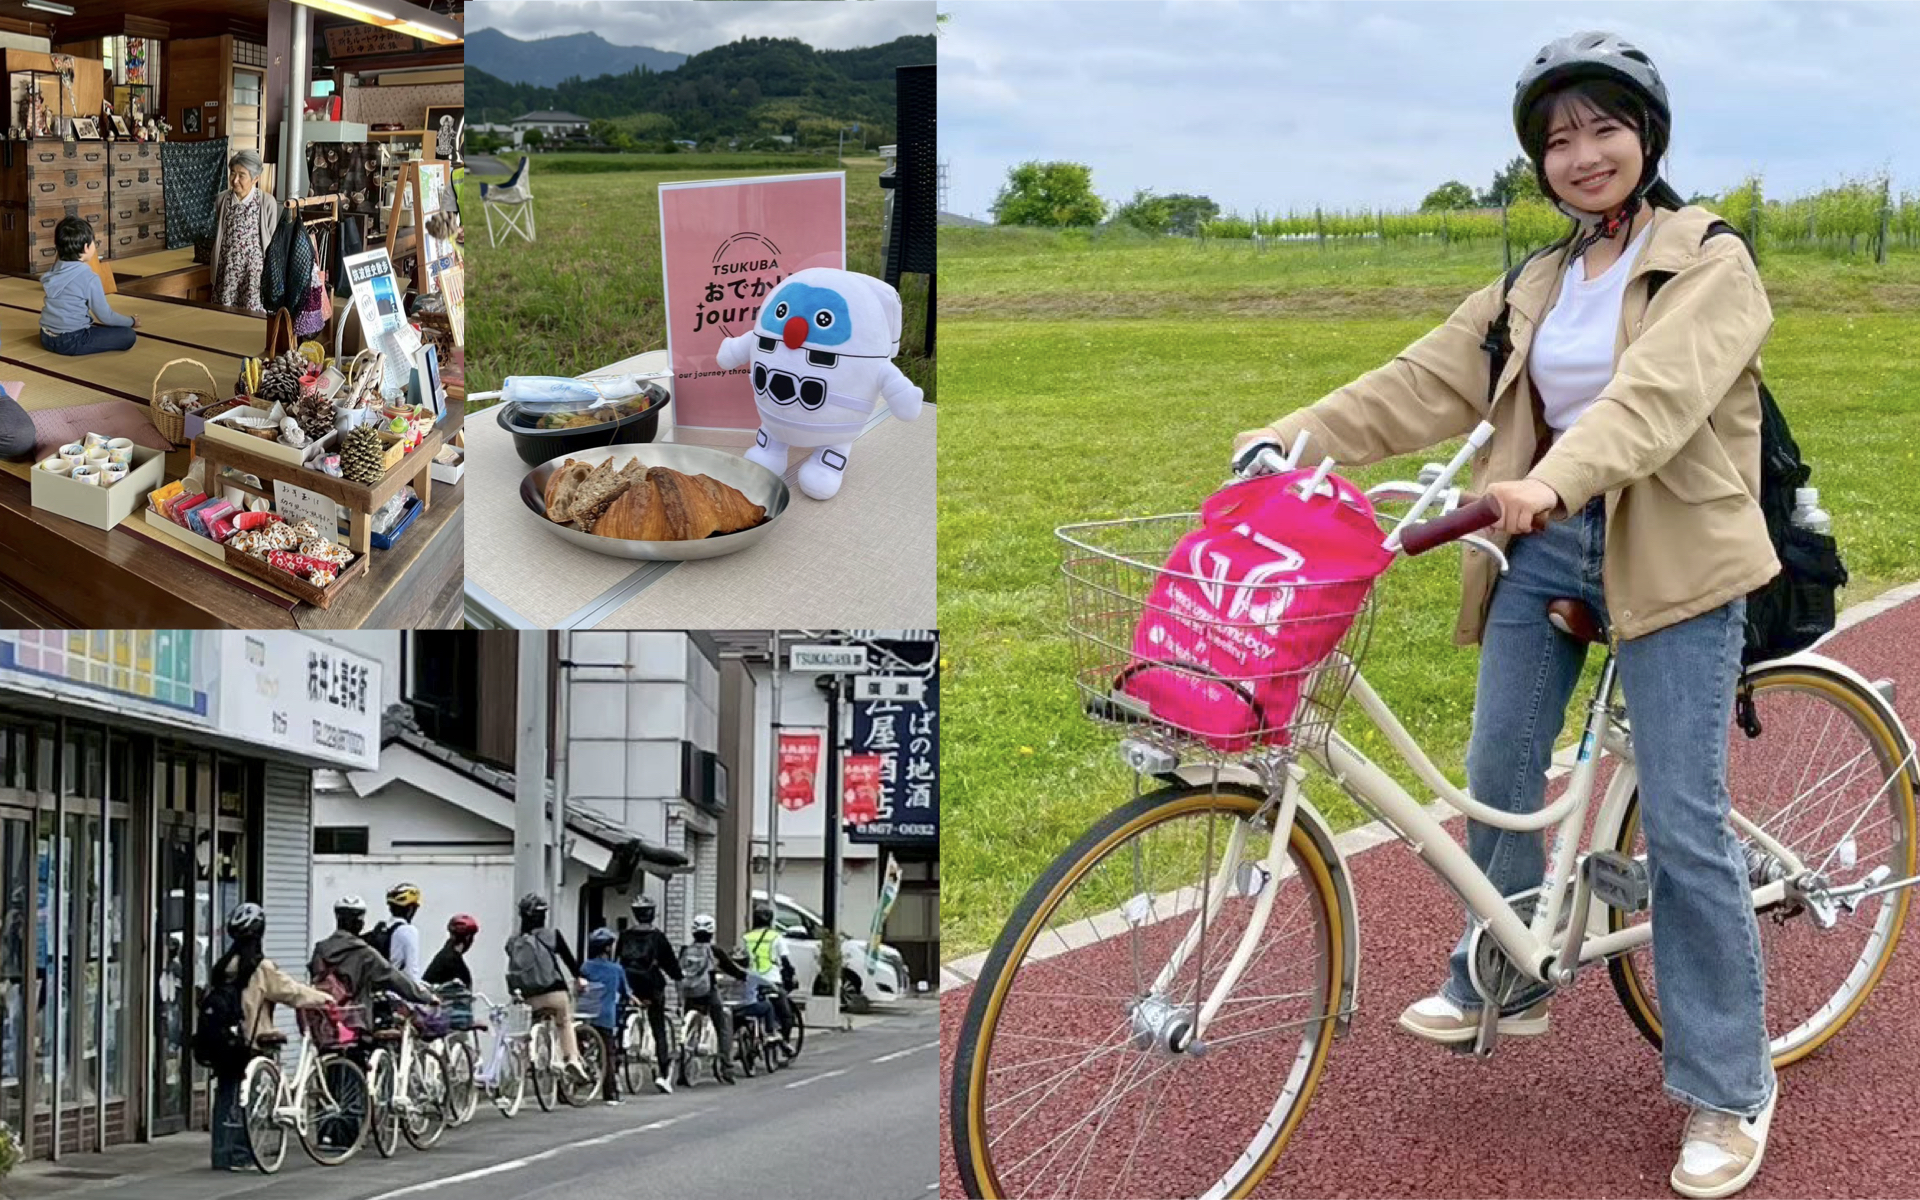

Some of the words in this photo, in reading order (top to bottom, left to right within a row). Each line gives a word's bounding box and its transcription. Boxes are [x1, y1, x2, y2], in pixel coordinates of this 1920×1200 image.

[713, 259, 778, 275] TSUKUBA
[693, 306, 760, 332] journ
[678, 371, 692, 379] our
[694, 369, 726, 380] journey
[728, 368, 751, 376] throu
